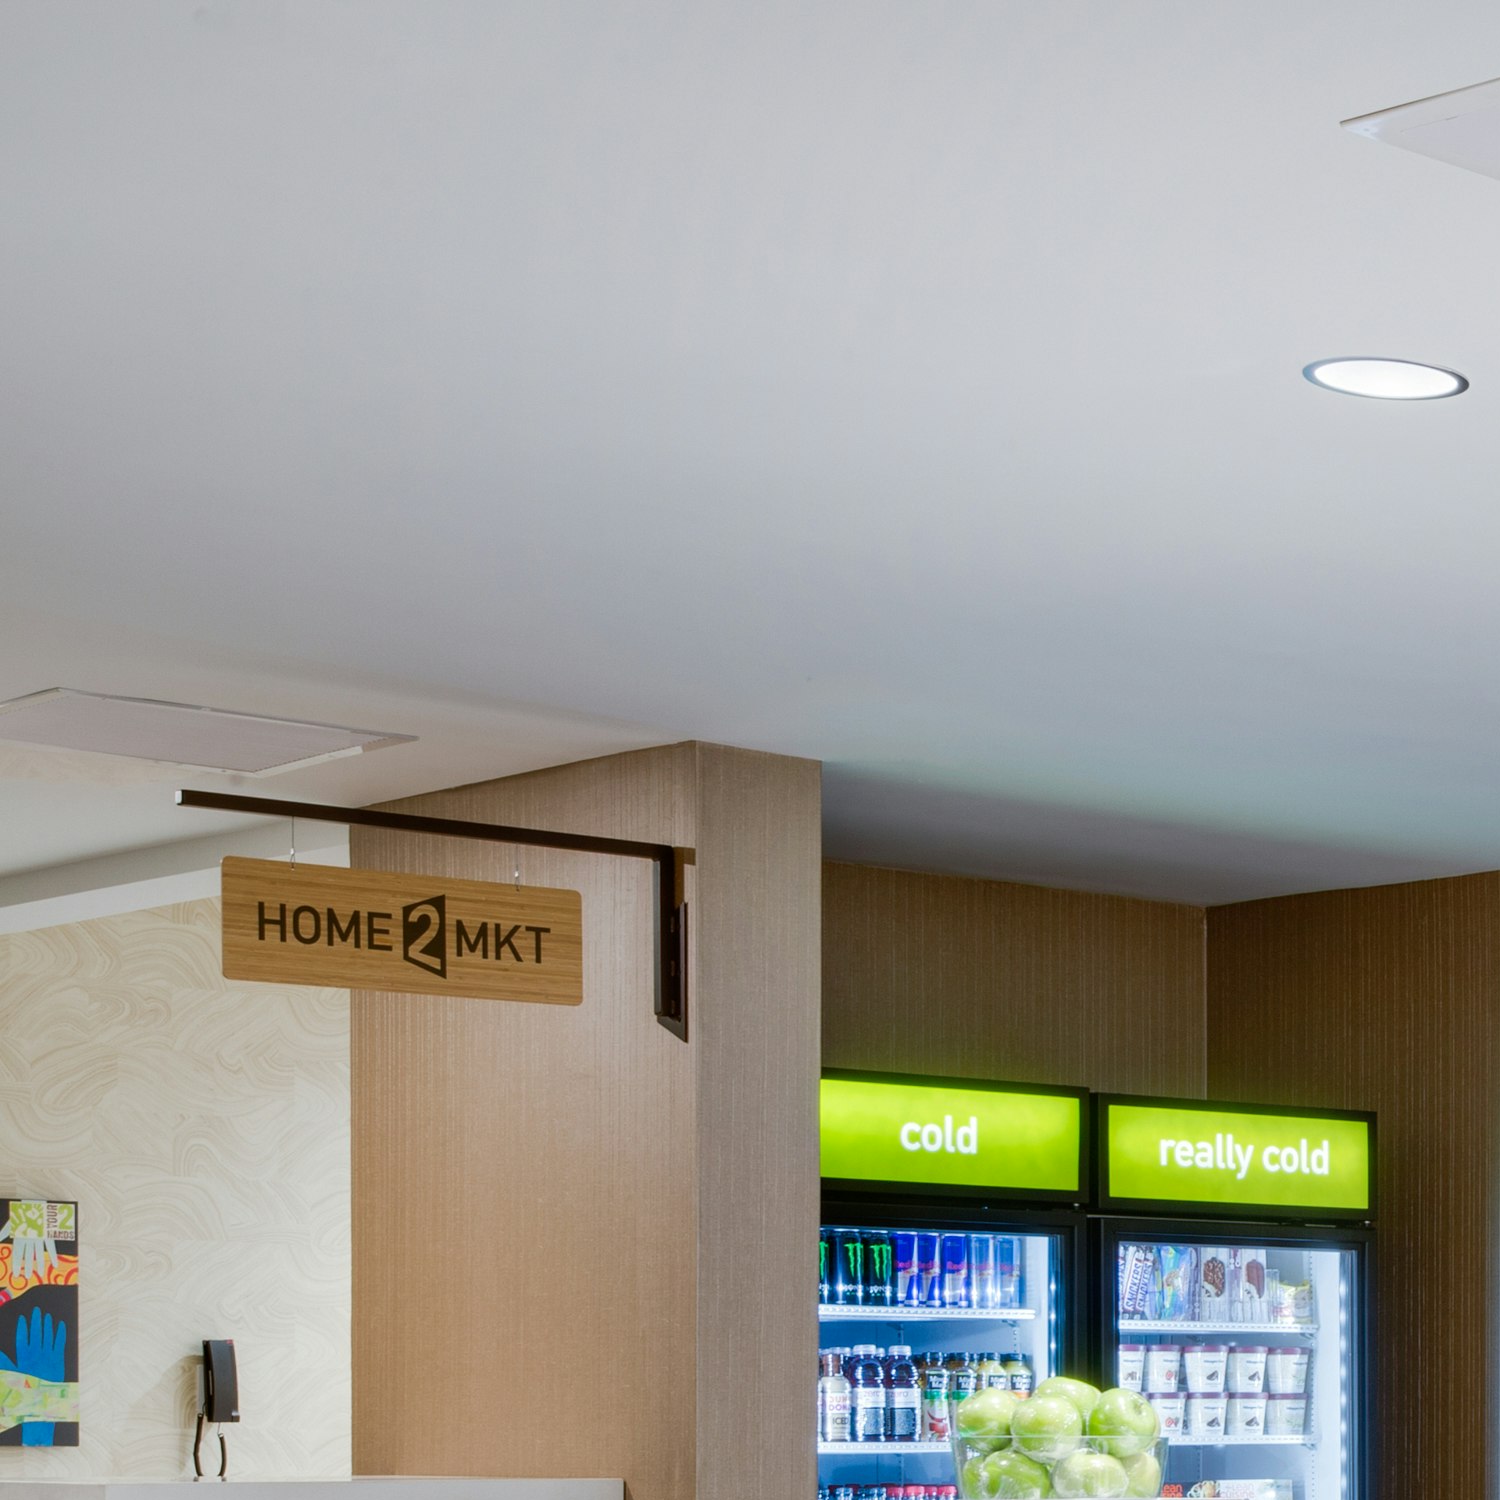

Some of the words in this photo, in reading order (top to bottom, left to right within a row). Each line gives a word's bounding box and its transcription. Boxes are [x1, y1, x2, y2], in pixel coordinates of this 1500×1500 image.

[256, 900, 393, 951] HOME
[455, 919, 552, 965] MKT
[900, 1114, 979, 1156] cold
[1160, 1133, 1255, 1180] really
[1262, 1138, 1330, 1175] cold
[57, 1203, 74, 1230] 2
